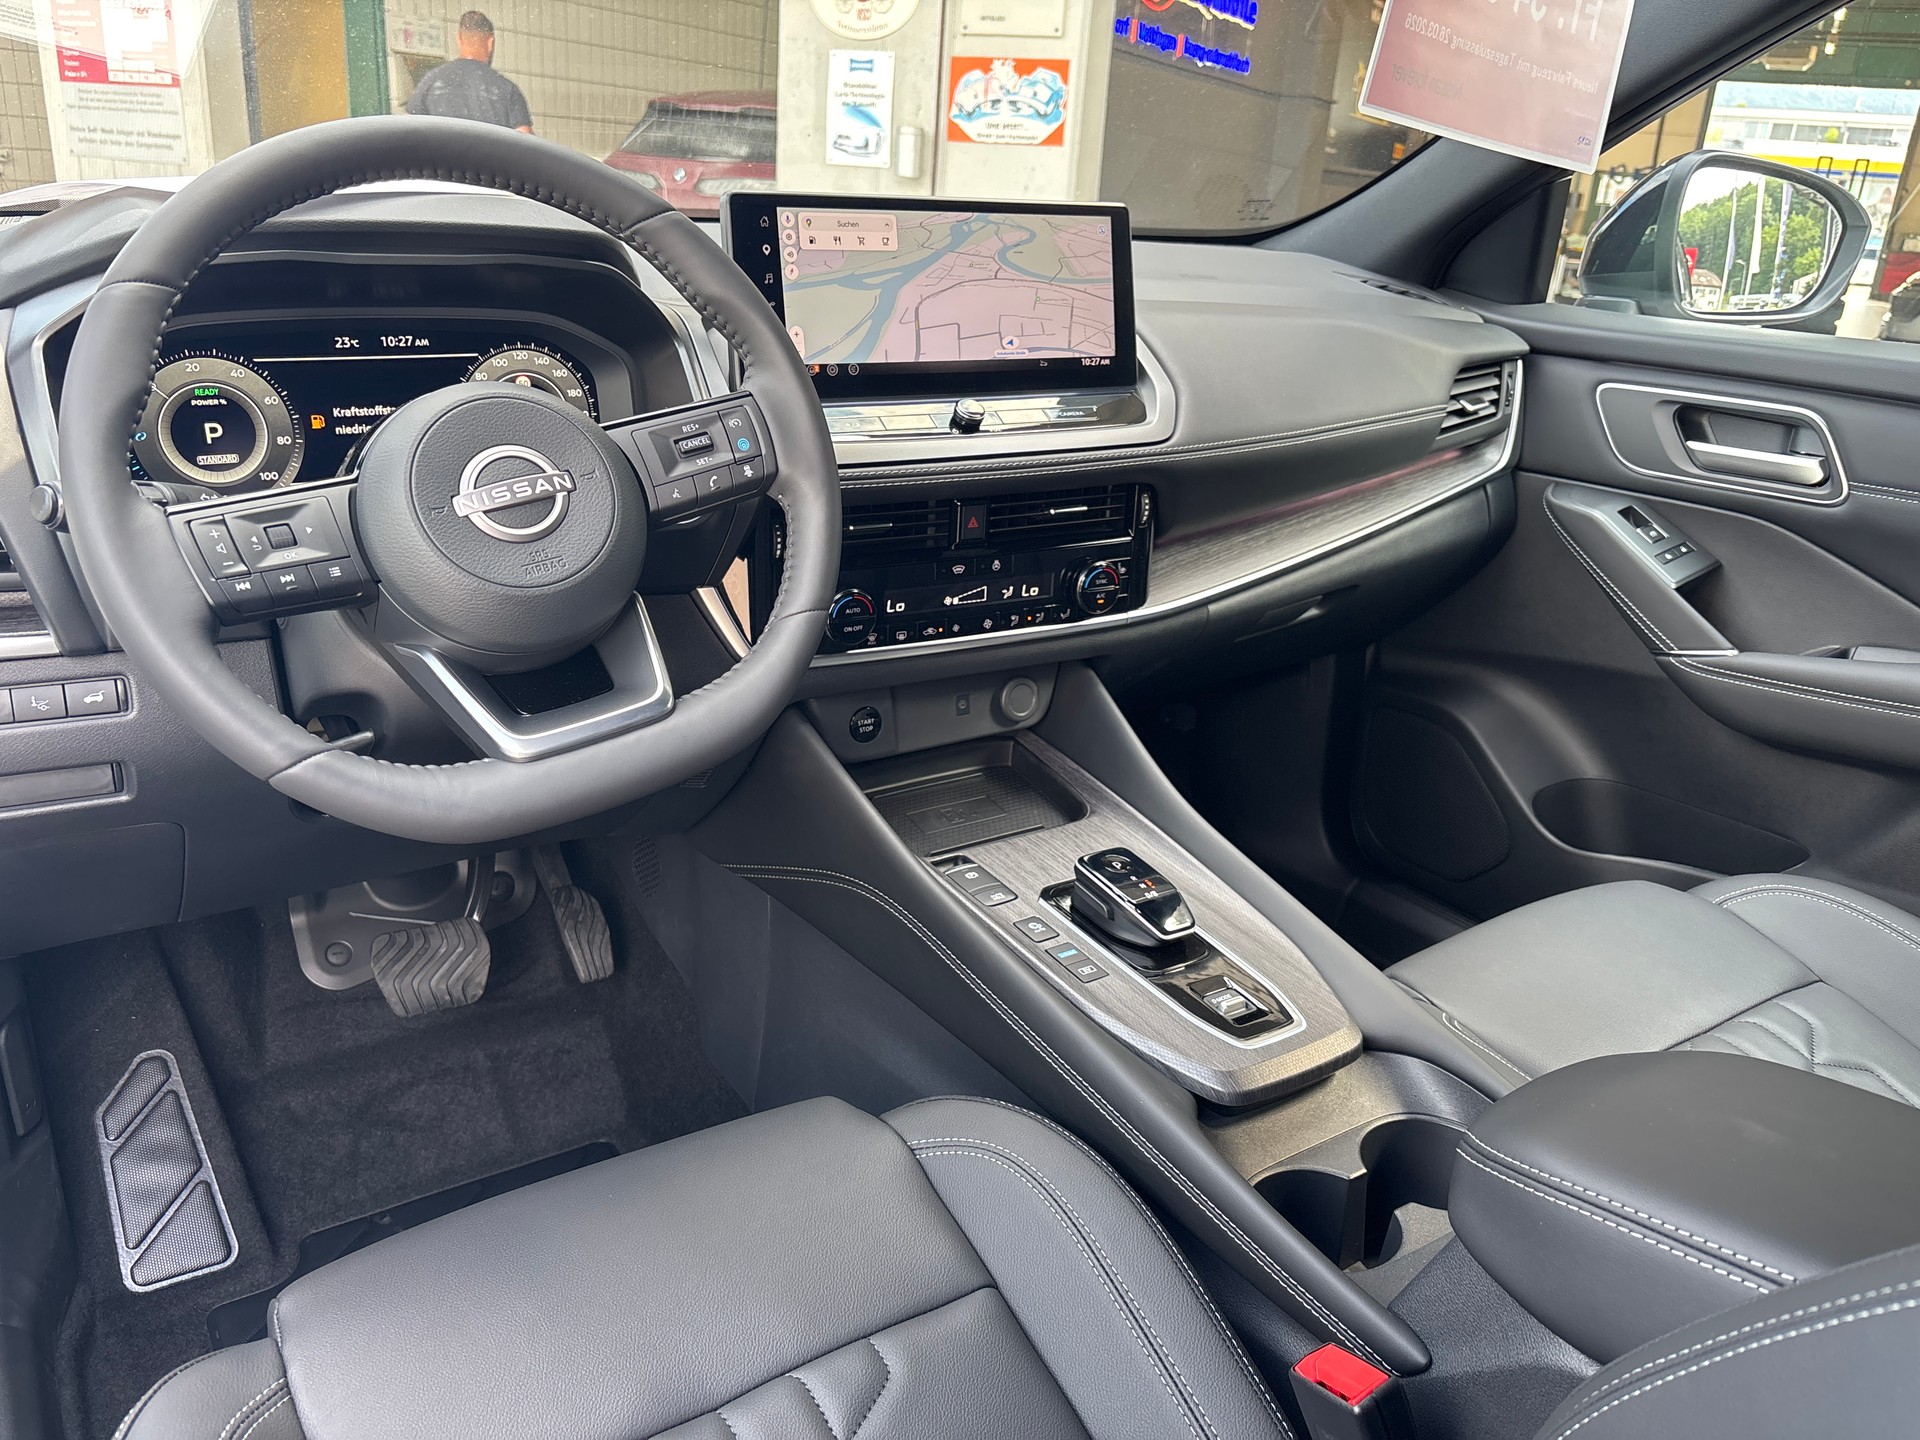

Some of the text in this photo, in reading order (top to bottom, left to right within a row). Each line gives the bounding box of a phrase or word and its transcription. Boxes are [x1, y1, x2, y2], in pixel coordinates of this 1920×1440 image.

[836, 220, 860, 229] Suchen
[380, 335, 413, 347] 10:27
[414, 338, 430, 347] AM
[512, 351, 528, 360] 120
[491, 358, 509, 367] 100
[533, 356, 550, 366] 140
[1080, 357, 1111, 367] 10:27 AM
[184, 362, 200, 373] 20
[230, 368, 246, 378] 40
[474, 371, 489, 381] 80
[551, 368, 568, 378] 160
[194, 388, 219, 396] READY
[566, 388, 582, 398] 180
[191, 399, 219, 407] POWER
[264, 395, 279, 406] 60
[332, 404, 397, 418] Kraftstoffst
[203, 421, 224, 445] P
[681, 423, 700, 433] RES+
[276, 435, 292, 446] 80
[682, 437, 711, 449] CANCEL
[197, 454, 239, 465] STANDARD
[259, 471, 279, 481] 100
[458, 473, 573, 513] NISSAN
[284, 550, 299, 561] OK
[529, 549, 550, 563] SRS
[524, 556, 568, 578] AIRBAG
[1021, 583, 1040, 597] Lo
[845, 607, 861, 615] AUTO
[886, 599, 906, 614] Lo
[857, 718, 875, 727] START
[859, 725, 874, 734] STOP
